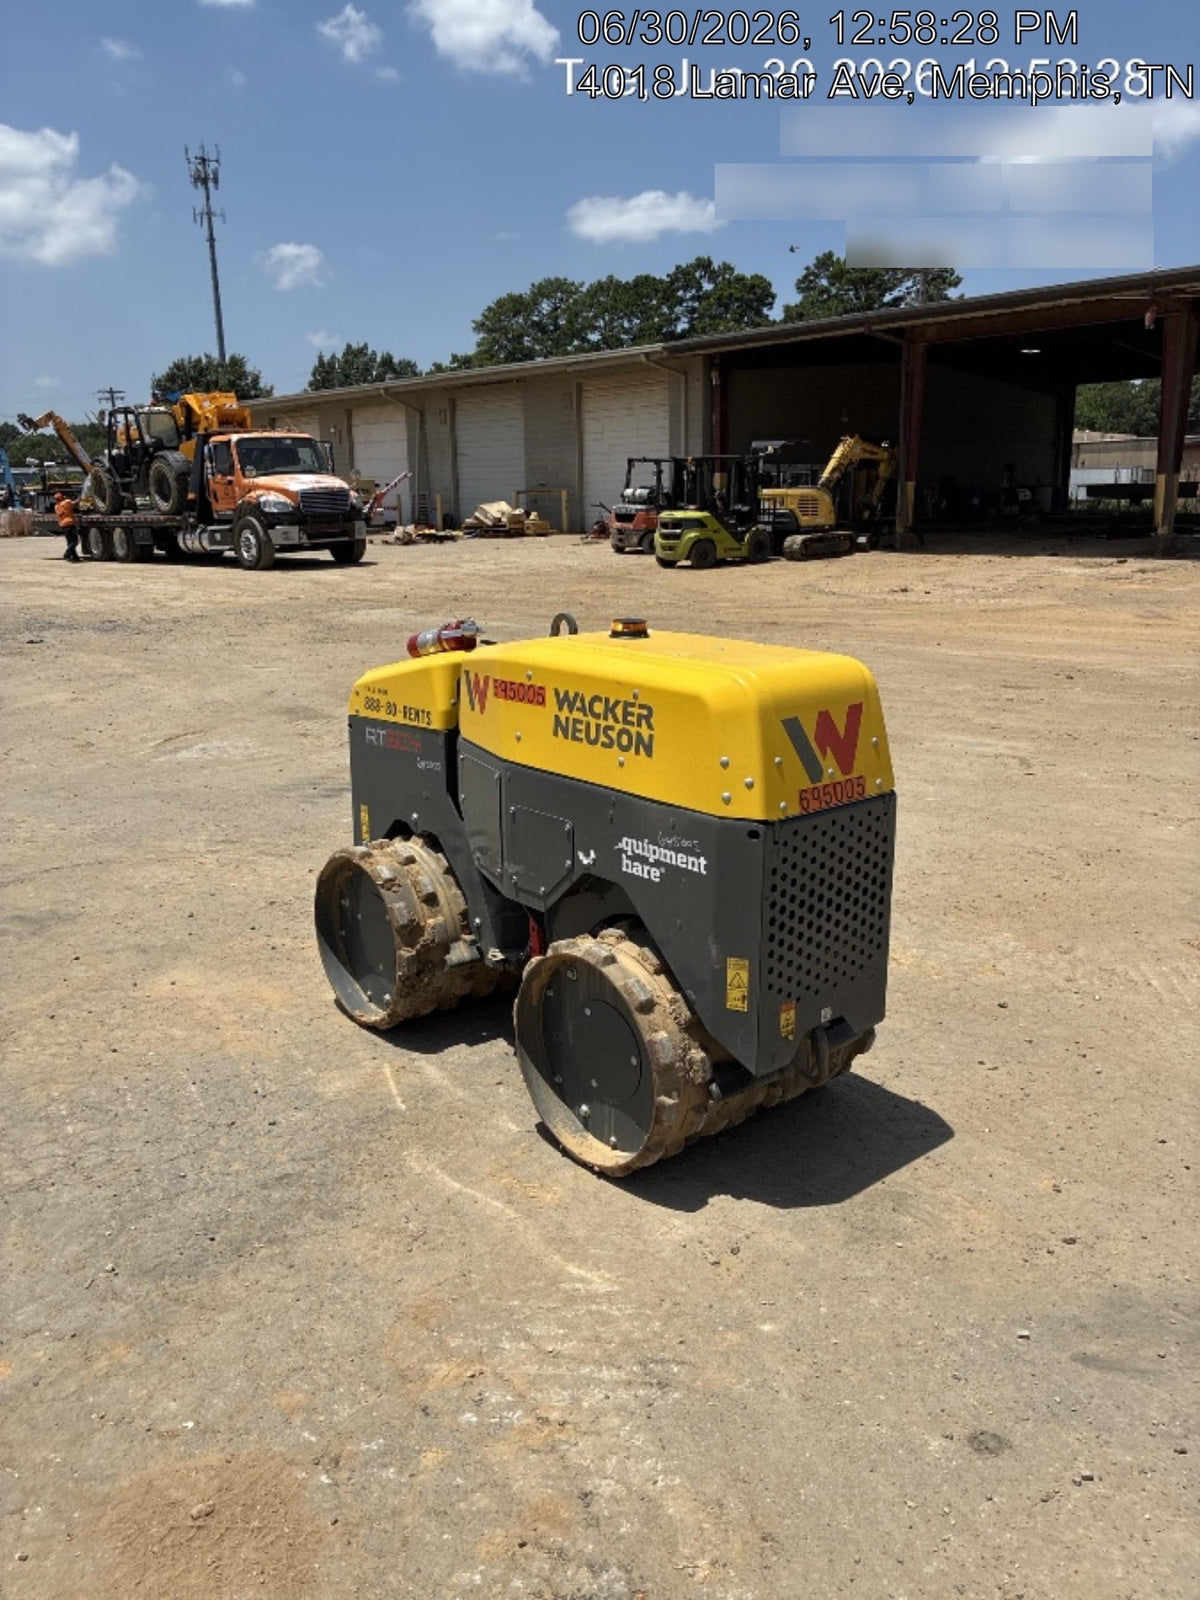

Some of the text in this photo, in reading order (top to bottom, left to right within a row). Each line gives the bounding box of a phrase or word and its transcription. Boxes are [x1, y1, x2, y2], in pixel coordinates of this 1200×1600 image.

[553, 687, 655, 731] WACKER
[552, 714, 654, 758] NEUSON
[614, 837, 707, 875] quipment
